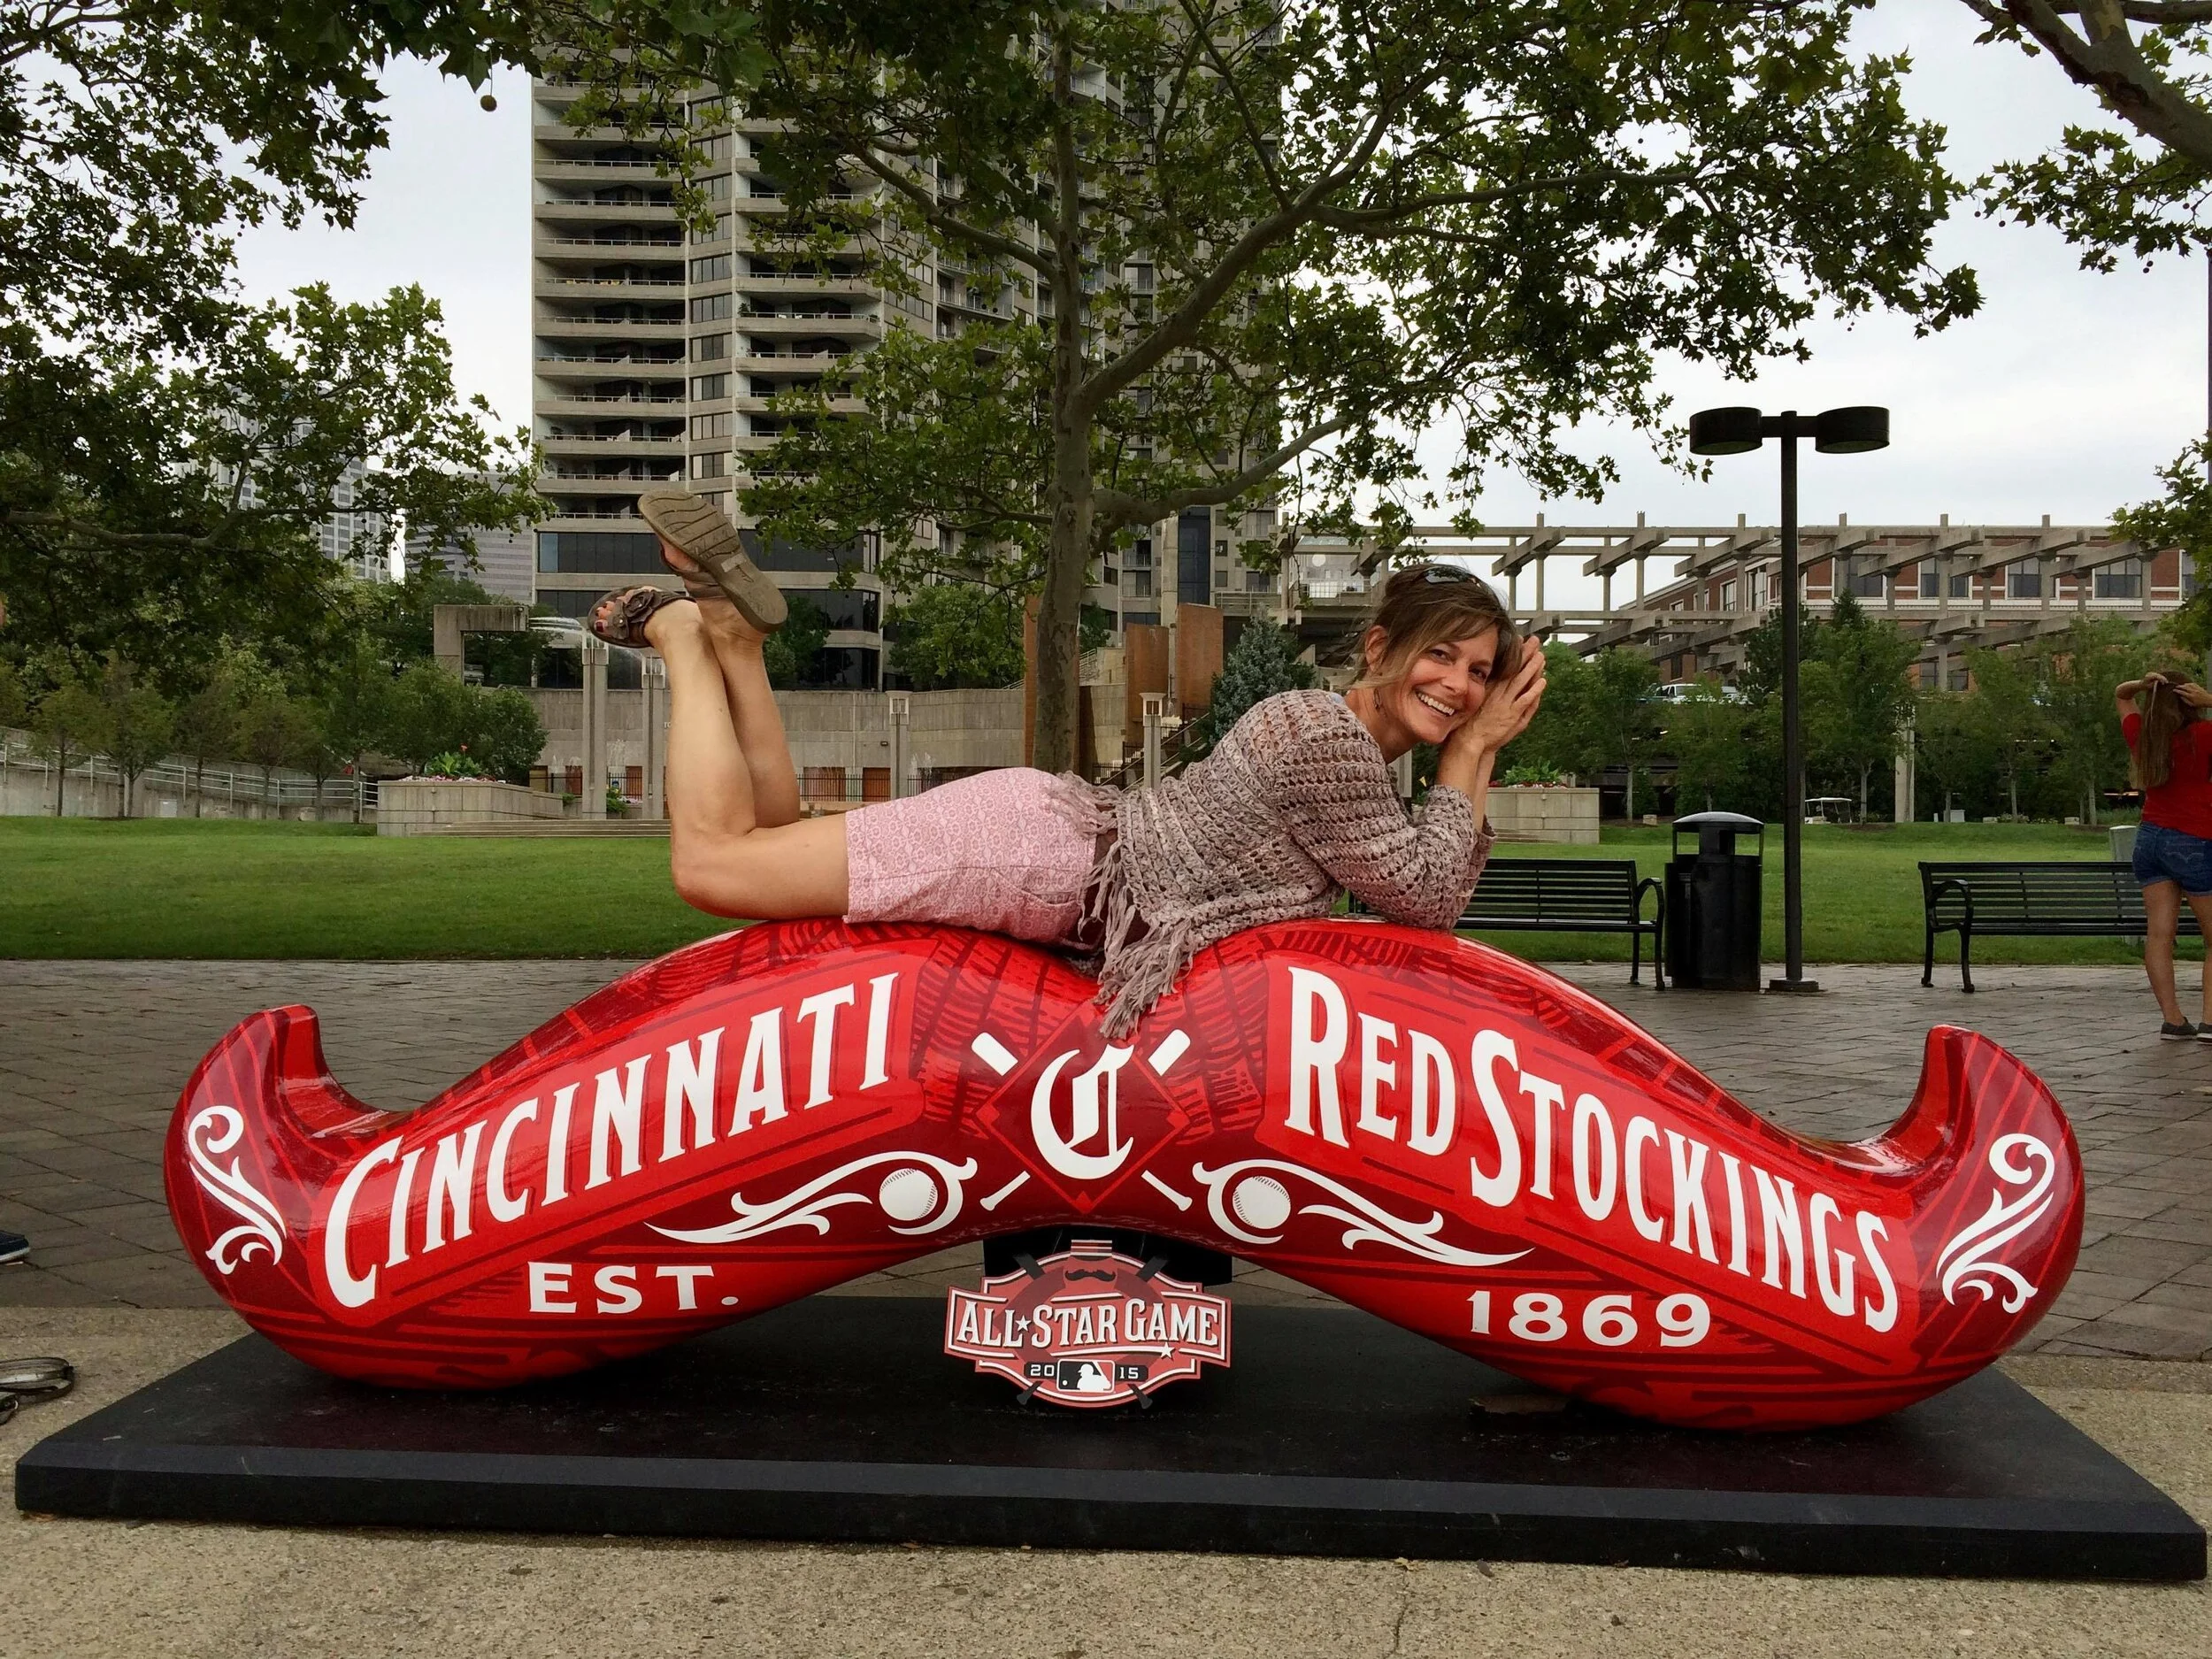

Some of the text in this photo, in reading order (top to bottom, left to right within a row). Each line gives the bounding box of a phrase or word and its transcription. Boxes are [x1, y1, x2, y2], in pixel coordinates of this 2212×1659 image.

[324, 972, 899, 1309] CINCINNATI
[1030, 1043, 1135, 1180] C
[1283, 965, 1899, 1333] RED STOCKINGS
[528, 1261, 740, 1314] EST.
[956, 1297, 1218, 1348] ALL STAR GAME
[1467, 1290, 1711, 1348] 1869
[1030, 1363, 1140, 1379] 20 15
